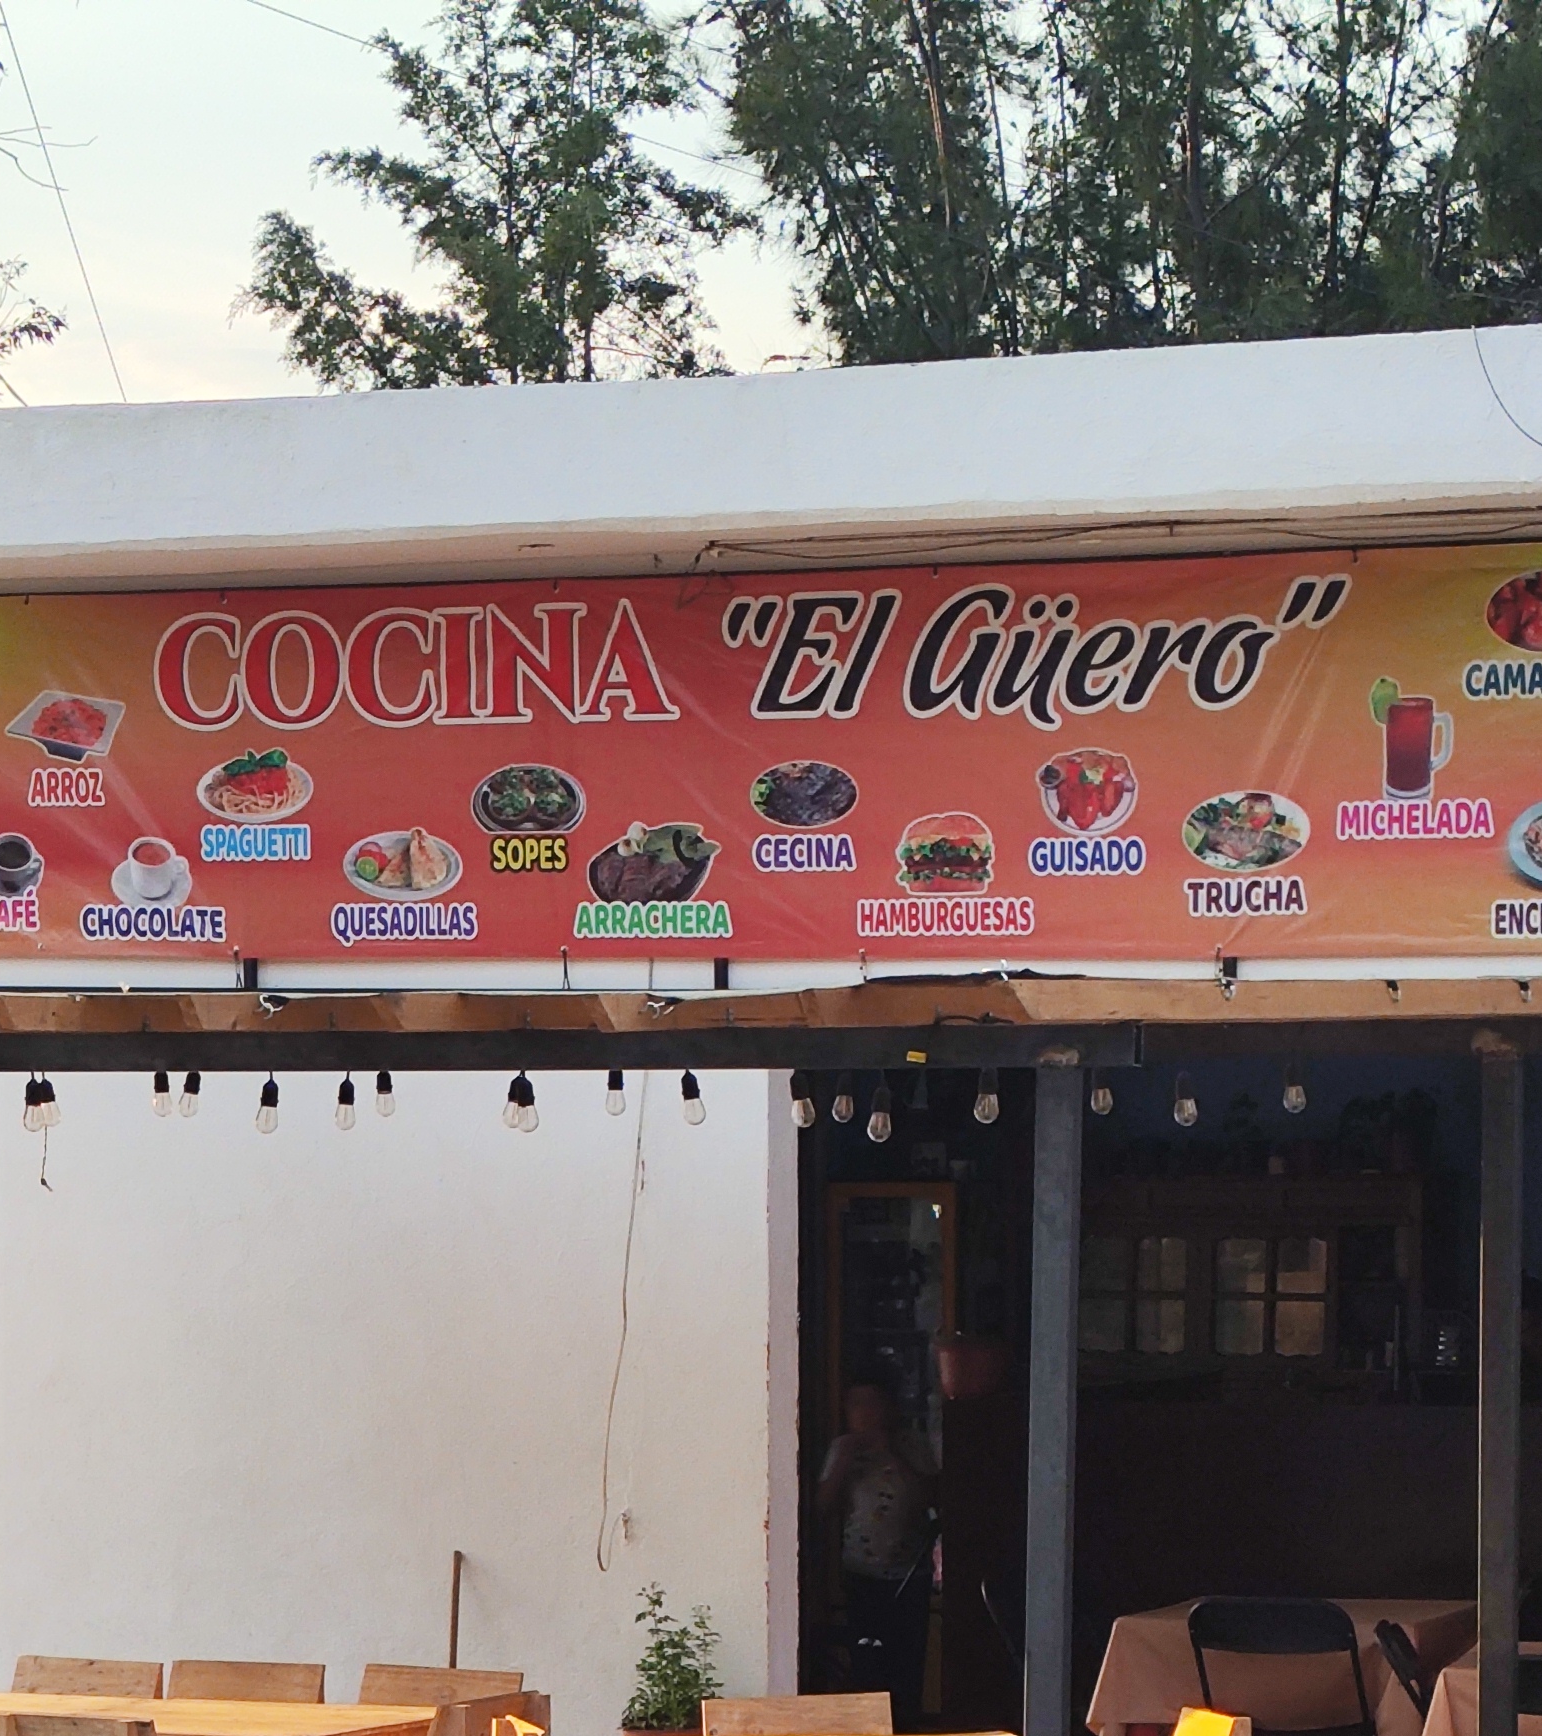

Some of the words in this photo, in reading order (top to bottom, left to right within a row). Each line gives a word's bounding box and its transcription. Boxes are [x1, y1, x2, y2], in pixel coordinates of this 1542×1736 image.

[154, 598, 681, 732] COCINA
[722, 588, 903, 720] "El
[902, 575, 1354, 732] Güero"
[28, 769, 105, 806] ARROZ
[1338, 799, 1494, 840] MICHELADA
[201, 825, 311, 861] SPAGUETTI
[490, 837, 568, 872] SOPES
[753, 836, 856, 871] CECINA
[1029, 838, 1146, 875] GUISADO
[1185, 878, 1307, 916] TRUCHA
[80, 906, 226, 942] CHOCOLATE
[331, 903, 478, 945] QUESADILLAS
[573, 902, 733, 938] ARRACHERA
[858, 898, 1035, 935] HAMBURGUESAS
